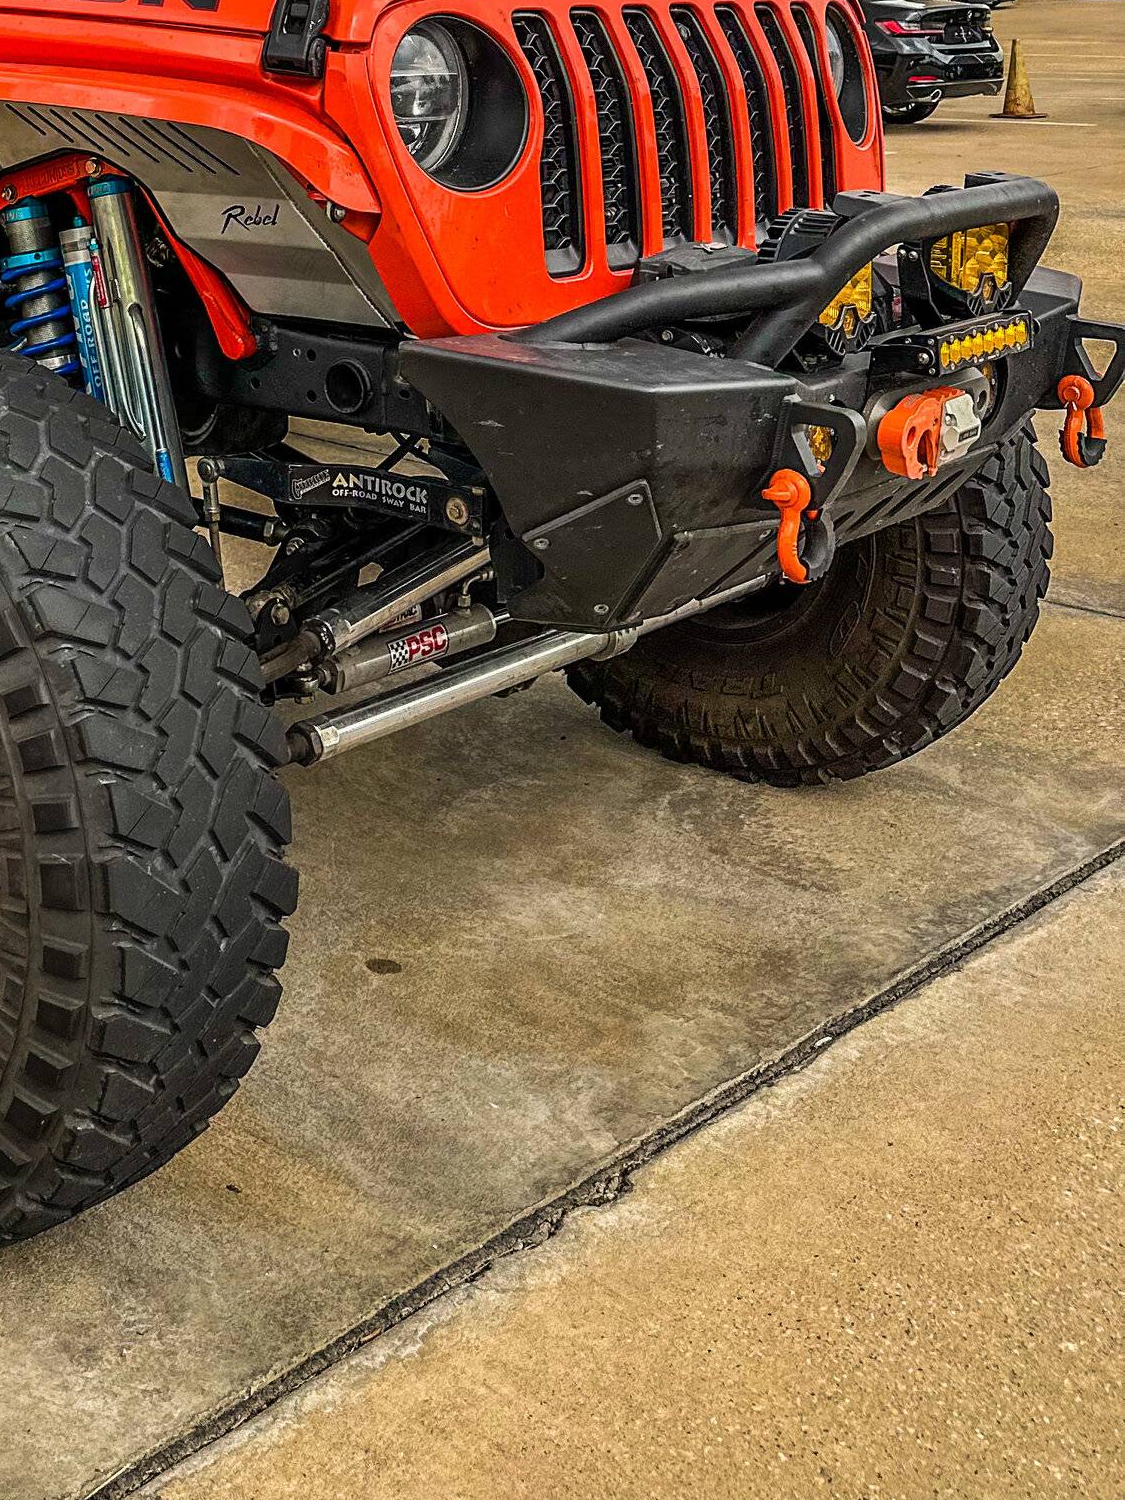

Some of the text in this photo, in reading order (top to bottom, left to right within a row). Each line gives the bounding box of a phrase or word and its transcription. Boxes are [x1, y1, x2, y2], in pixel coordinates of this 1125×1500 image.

[221, 203, 280, 235] Rebel
[332, 472, 428, 505] ANTIROCK
[332, 488, 427, 514] OFF-ROAD SWAY BAR
[406, 625, 448, 661] PSC
